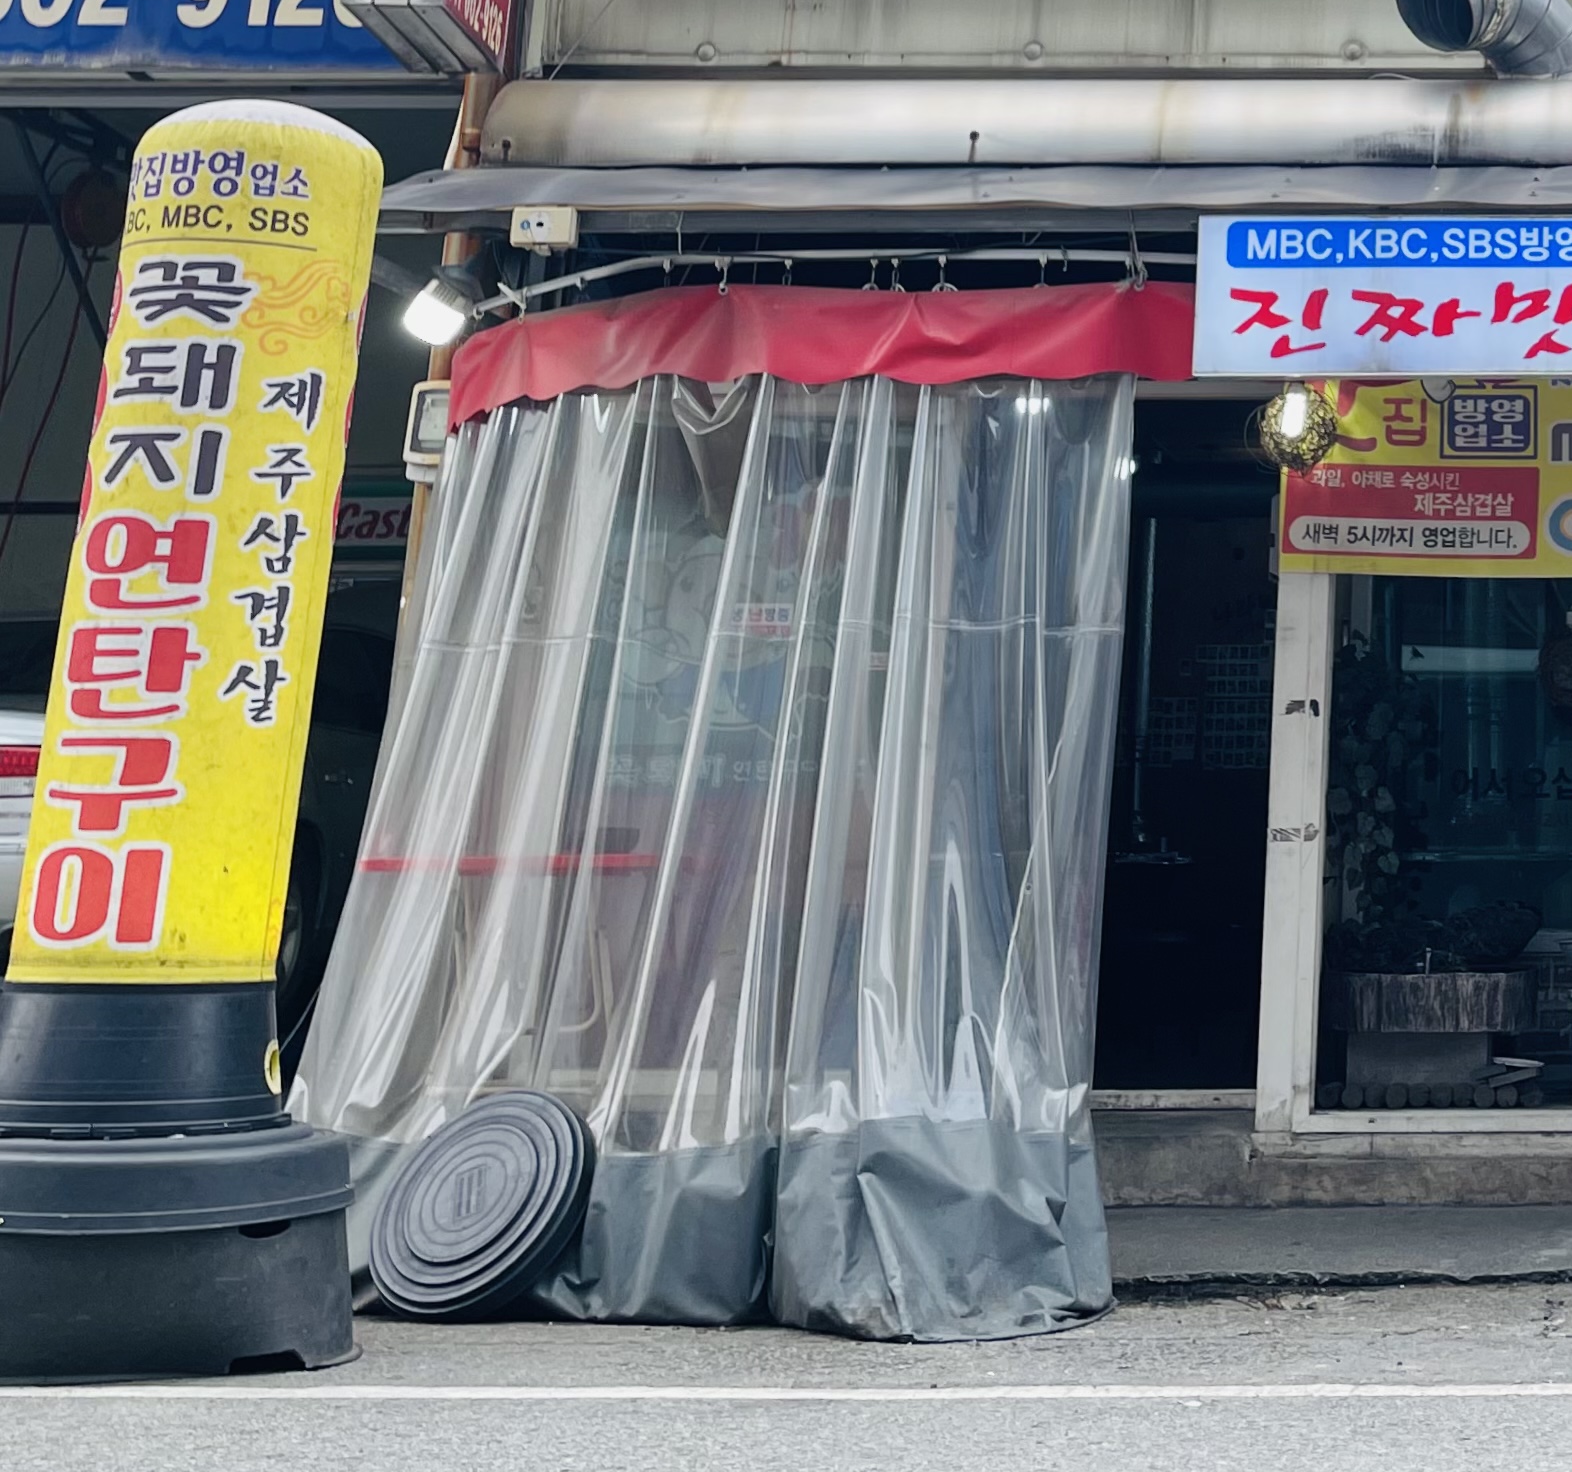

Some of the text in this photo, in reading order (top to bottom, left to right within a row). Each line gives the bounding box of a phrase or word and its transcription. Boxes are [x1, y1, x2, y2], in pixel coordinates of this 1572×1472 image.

[124, 204, 310, 237] BC, MBC, SBS
[1454, 398, 1526, 423] 방영
[1454, 424, 1525, 448] 업소
[1400, 472, 1460, 491] 숙성시킨
[1413, 492, 1515, 517] 제주삼겹살
[222, 373, 323, 722] 제주삼겹살
[1302, 523, 1519, 549] 새벽 5시까지 영업합니다.
